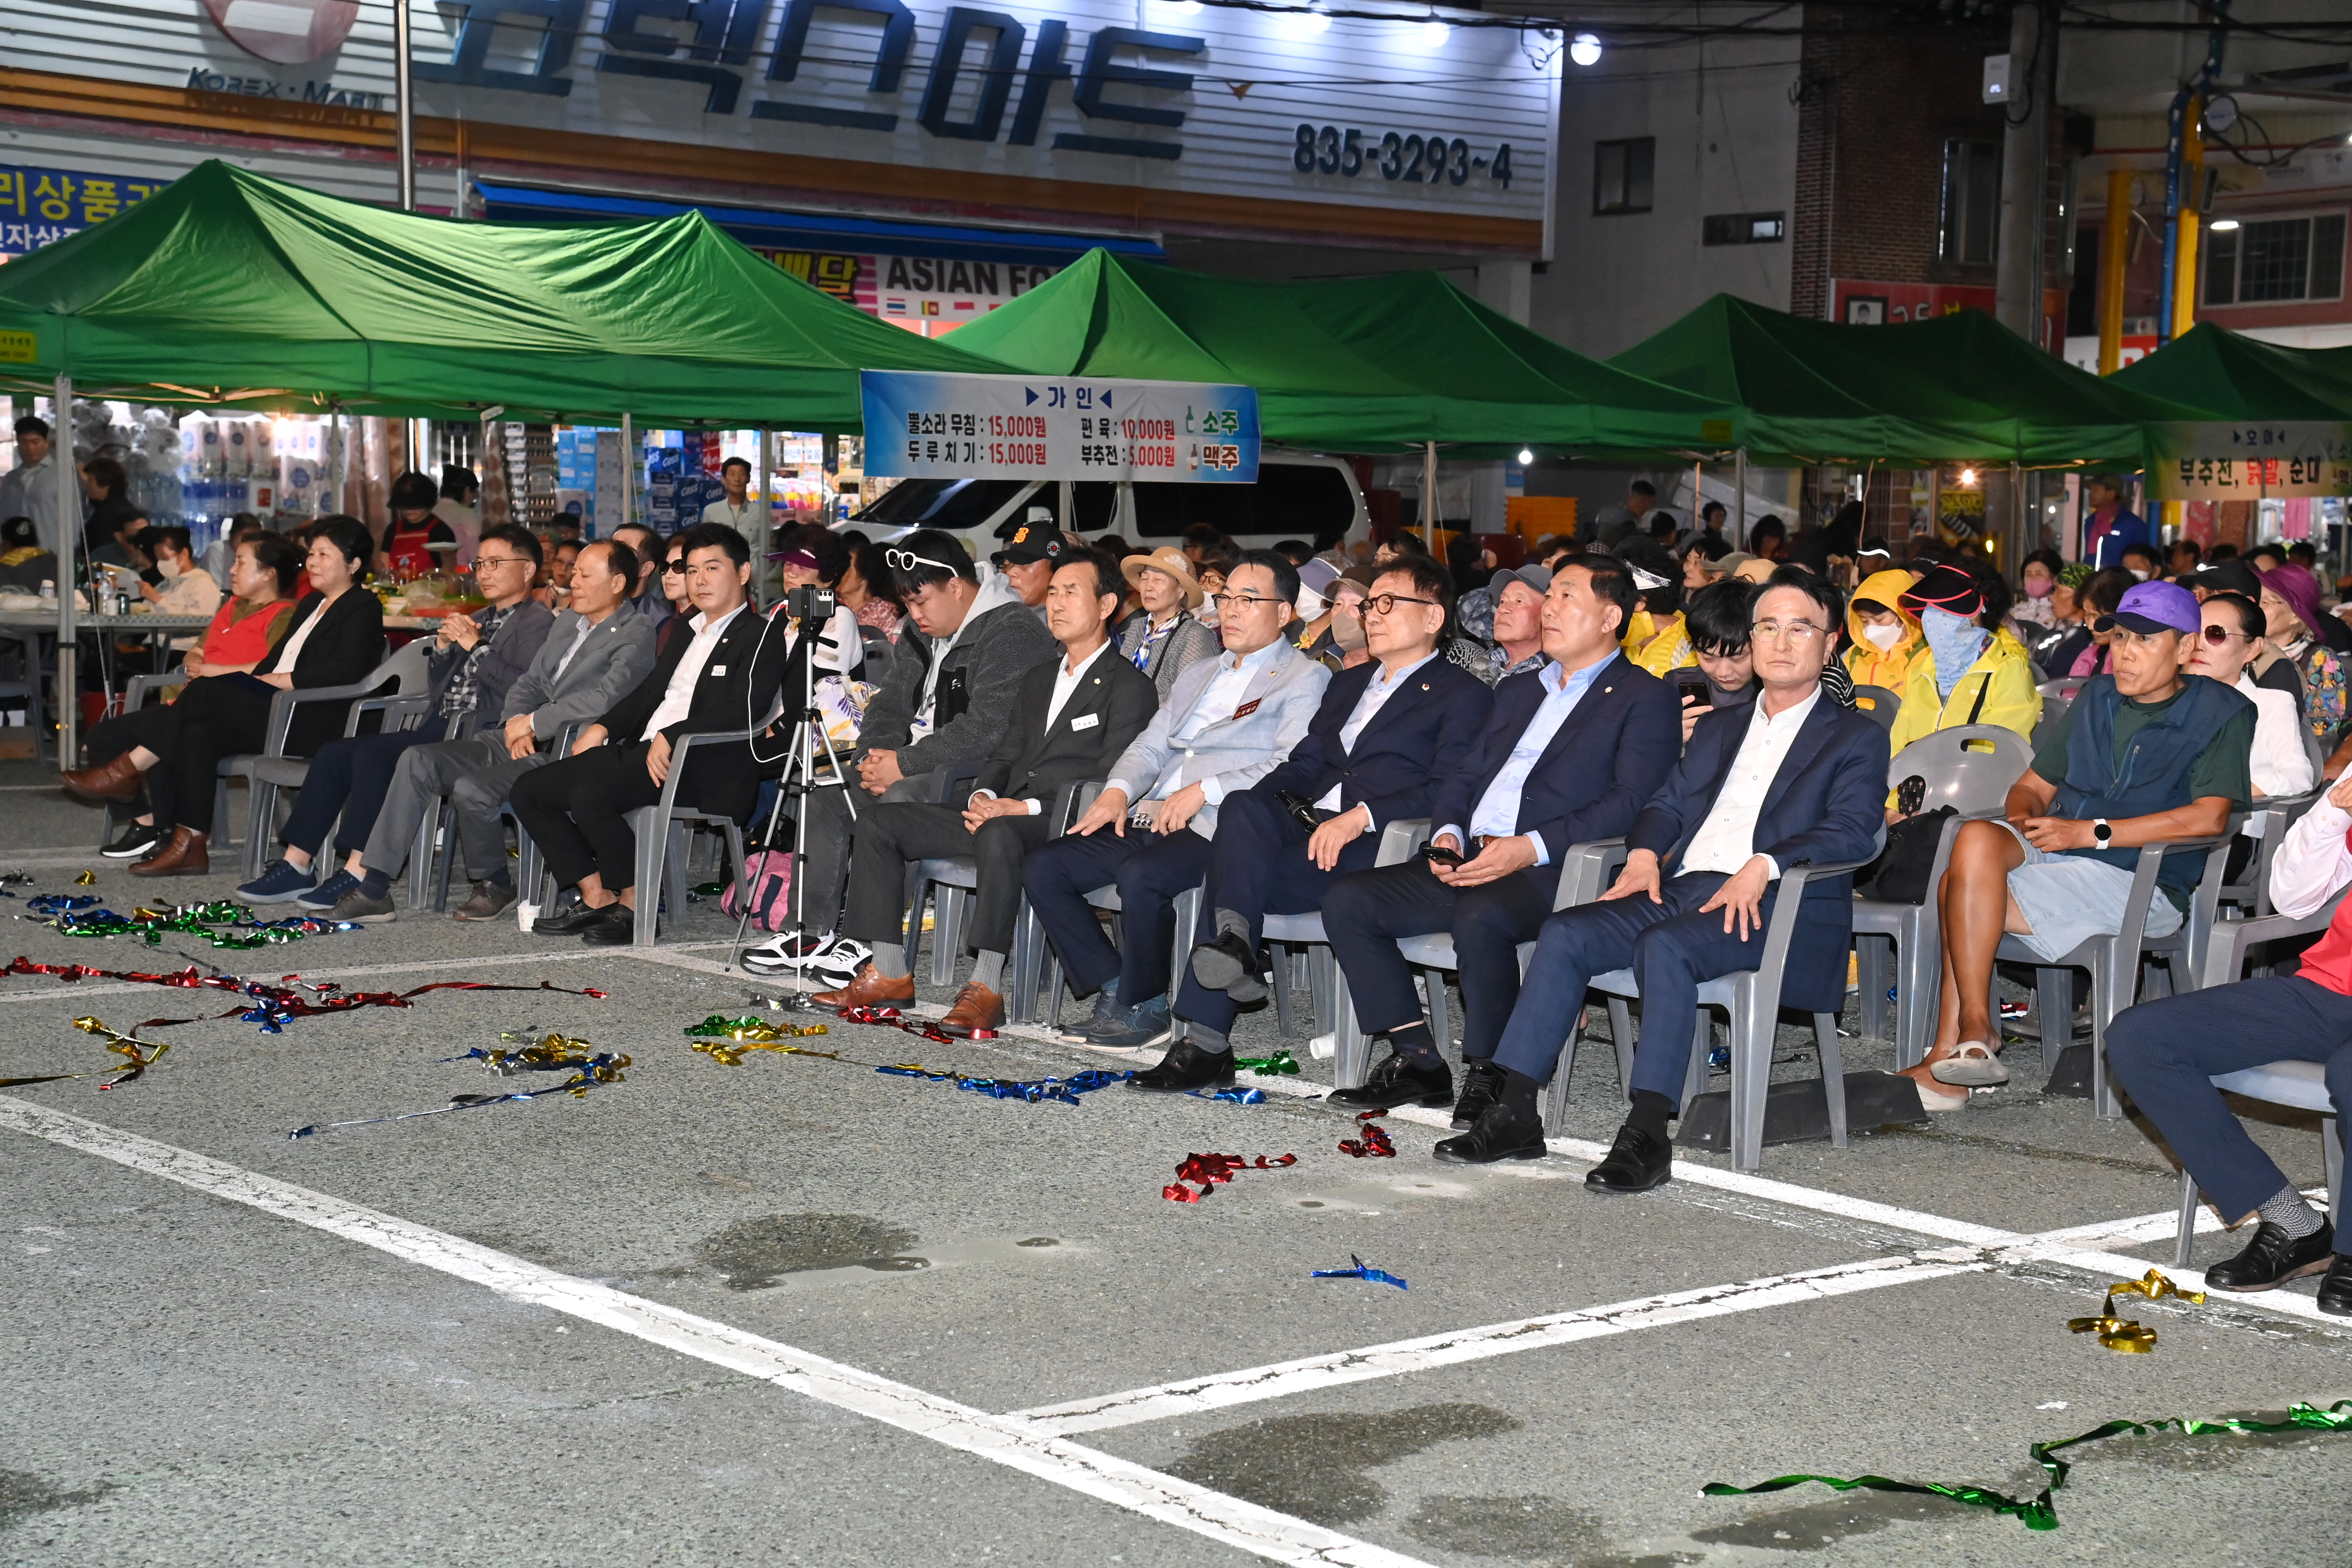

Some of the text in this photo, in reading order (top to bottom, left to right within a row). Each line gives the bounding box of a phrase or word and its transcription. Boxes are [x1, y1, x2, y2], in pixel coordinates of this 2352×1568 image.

[1293, 123, 1513, 189] 835-3293~4
[887, 257, 1065, 297] ASIAN FO
[907, 412, 947, 435] 뿔소라
[951, 413, 975, 436] 무침
[988, 415, 1046, 439] 15,000원
[1121, 418, 1175, 442] 10,000원
[1202, 410, 1239, 435] 소주
[988, 443, 1046, 467] 15,000원
[1081, 444, 1119, 466] 부추전
[1129, 446, 1175, 469] 5,000원
[1202, 444, 1240, 471] 맥주
[680, 483, 723, 500] Cass Cass
[681, 514, 698, 527] Cass
